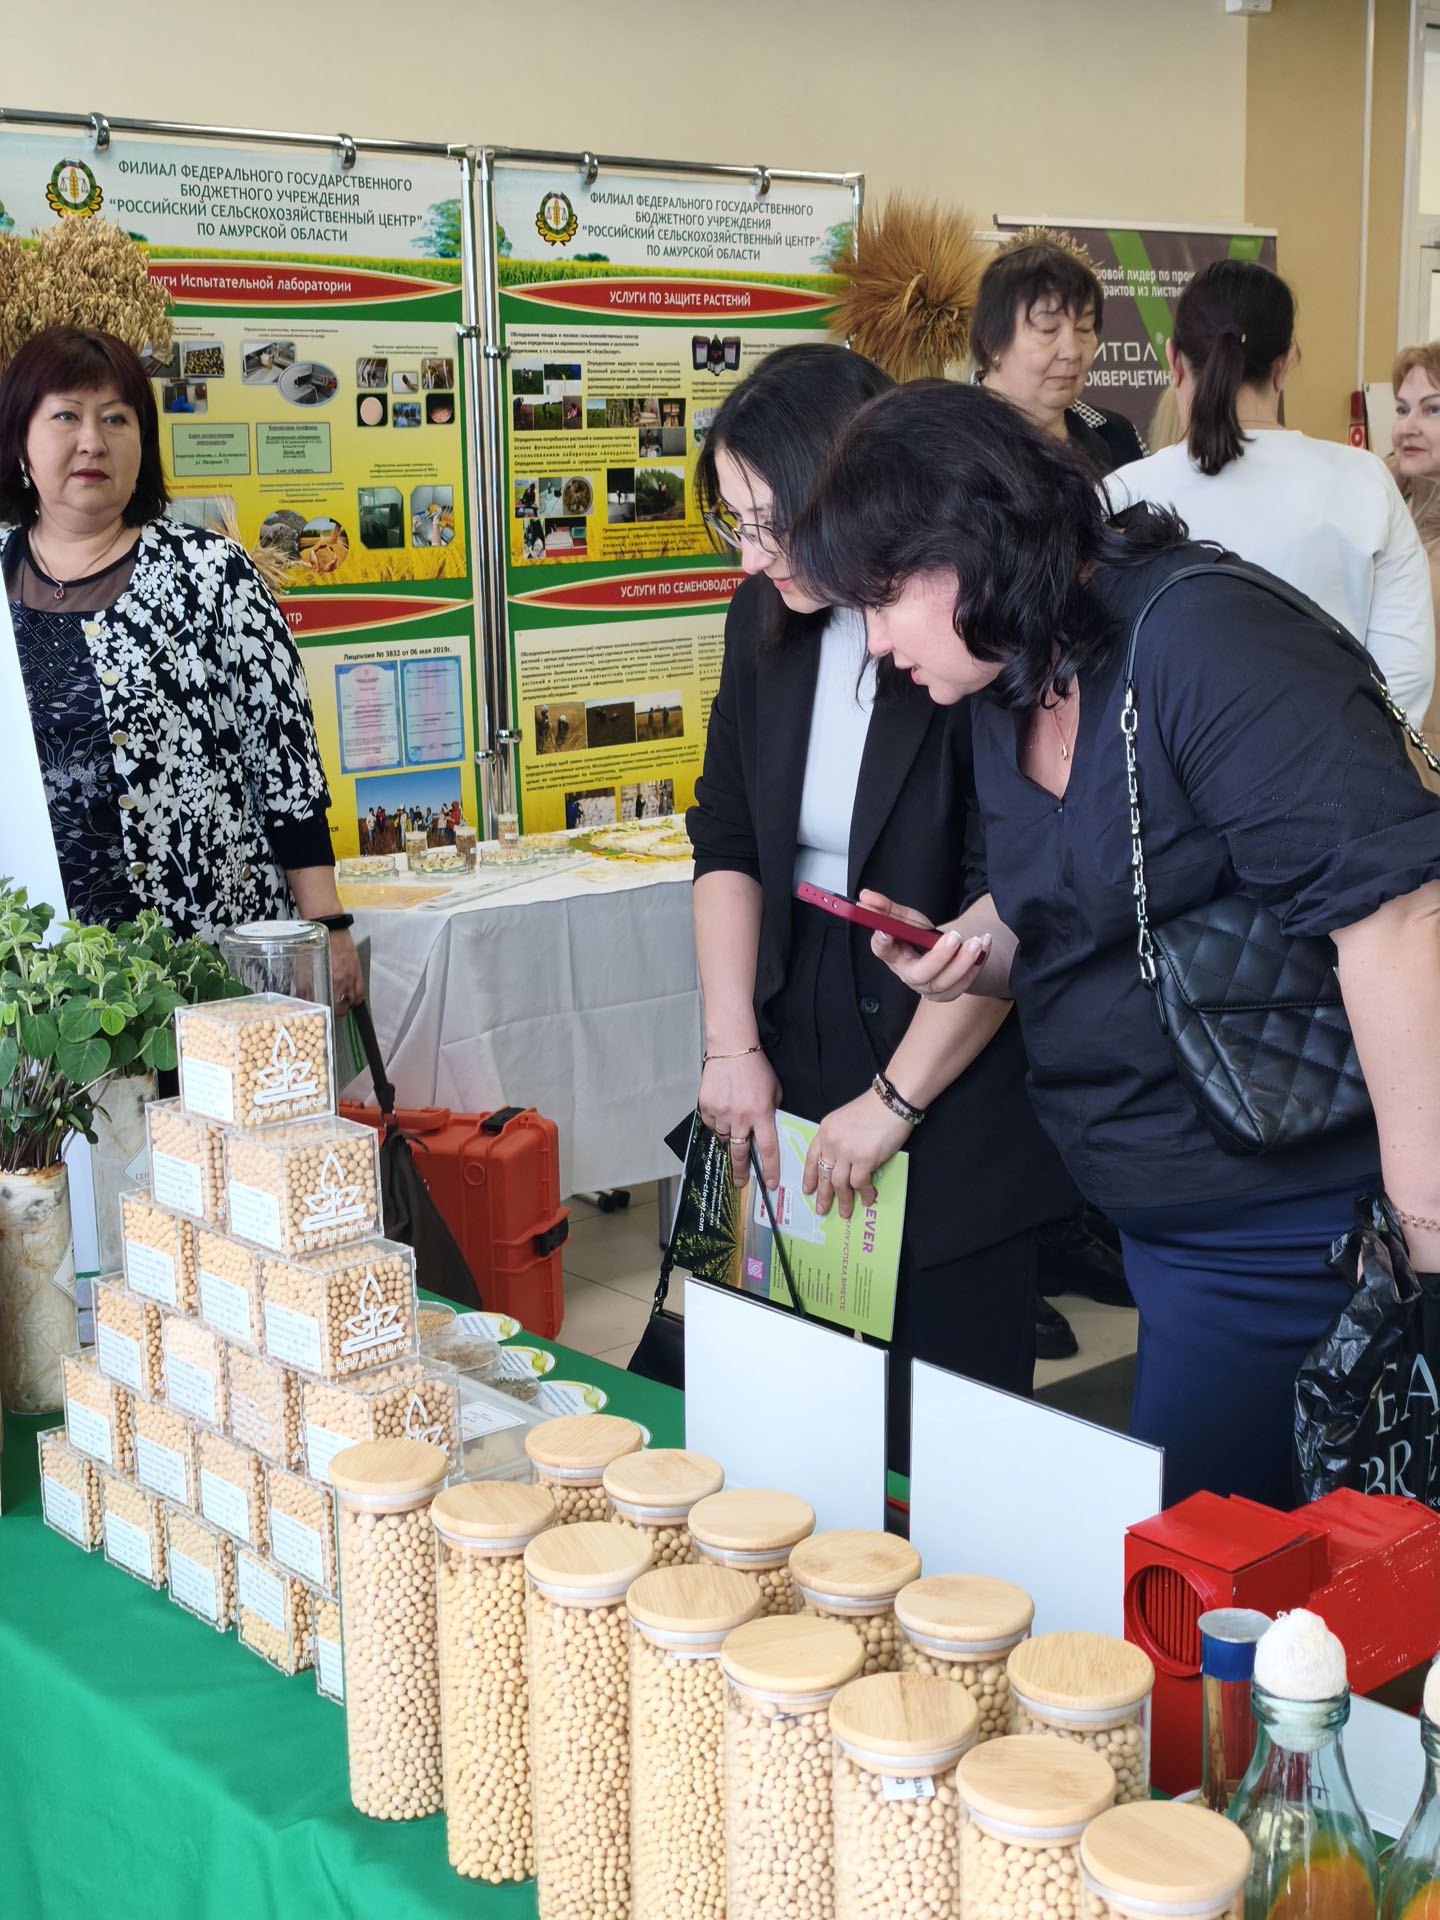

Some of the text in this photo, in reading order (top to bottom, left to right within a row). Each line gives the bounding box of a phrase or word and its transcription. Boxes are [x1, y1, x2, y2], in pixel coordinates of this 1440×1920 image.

[118, 160, 412, 192] ФИЛИАЛ ФЕДЕРАЛЬНОГО ГОСУДАРСТВЕННОГО
[180, 183, 359, 207] БЮДЖЕТНОГО УЧРЕЖДЕНИЯ
[590, 192, 814, 217] ФИЛИАЛ ФЕДЕРАЛЬНОГО ГОСУДАРСТВЕННОГО
[211, 202, 374, 226] СЕЛЬСКОХОЗЯЙСТВЕННЫЙ
[636, 211, 771, 229] БЮДЖЕТНОГО УЧРЕЖДЕНИЯ
[197, 222, 348, 242] ПО АМУРСКОЙ ОБЛАСТИ
[657, 227, 783, 247] СЕЛЬСКОХОЗЯЙСТВЕННЫЙ
[647, 244, 760, 261] ПО АМУРСКОЙ ОБЛАСТИ
[181, 273, 274, 291] Испытательной
[277, 277, 351, 295] лаборатории
[1127, 269, 1156, 284] лидер
[1158, 270, 1170, 282] по
[610, 290, 750, 307] УСЛУГИ ПО ЗАЩИТЕ РАСТЕНИЙ
[1137, 286, 1149, 297] из
[621, 584, 656, 599] УСЛУГИ
[659, 582, 671, 595] ПО
[386, 649, 401, 658] 3832
[699, 1137, 716, 1231] www.agro-clever.com
